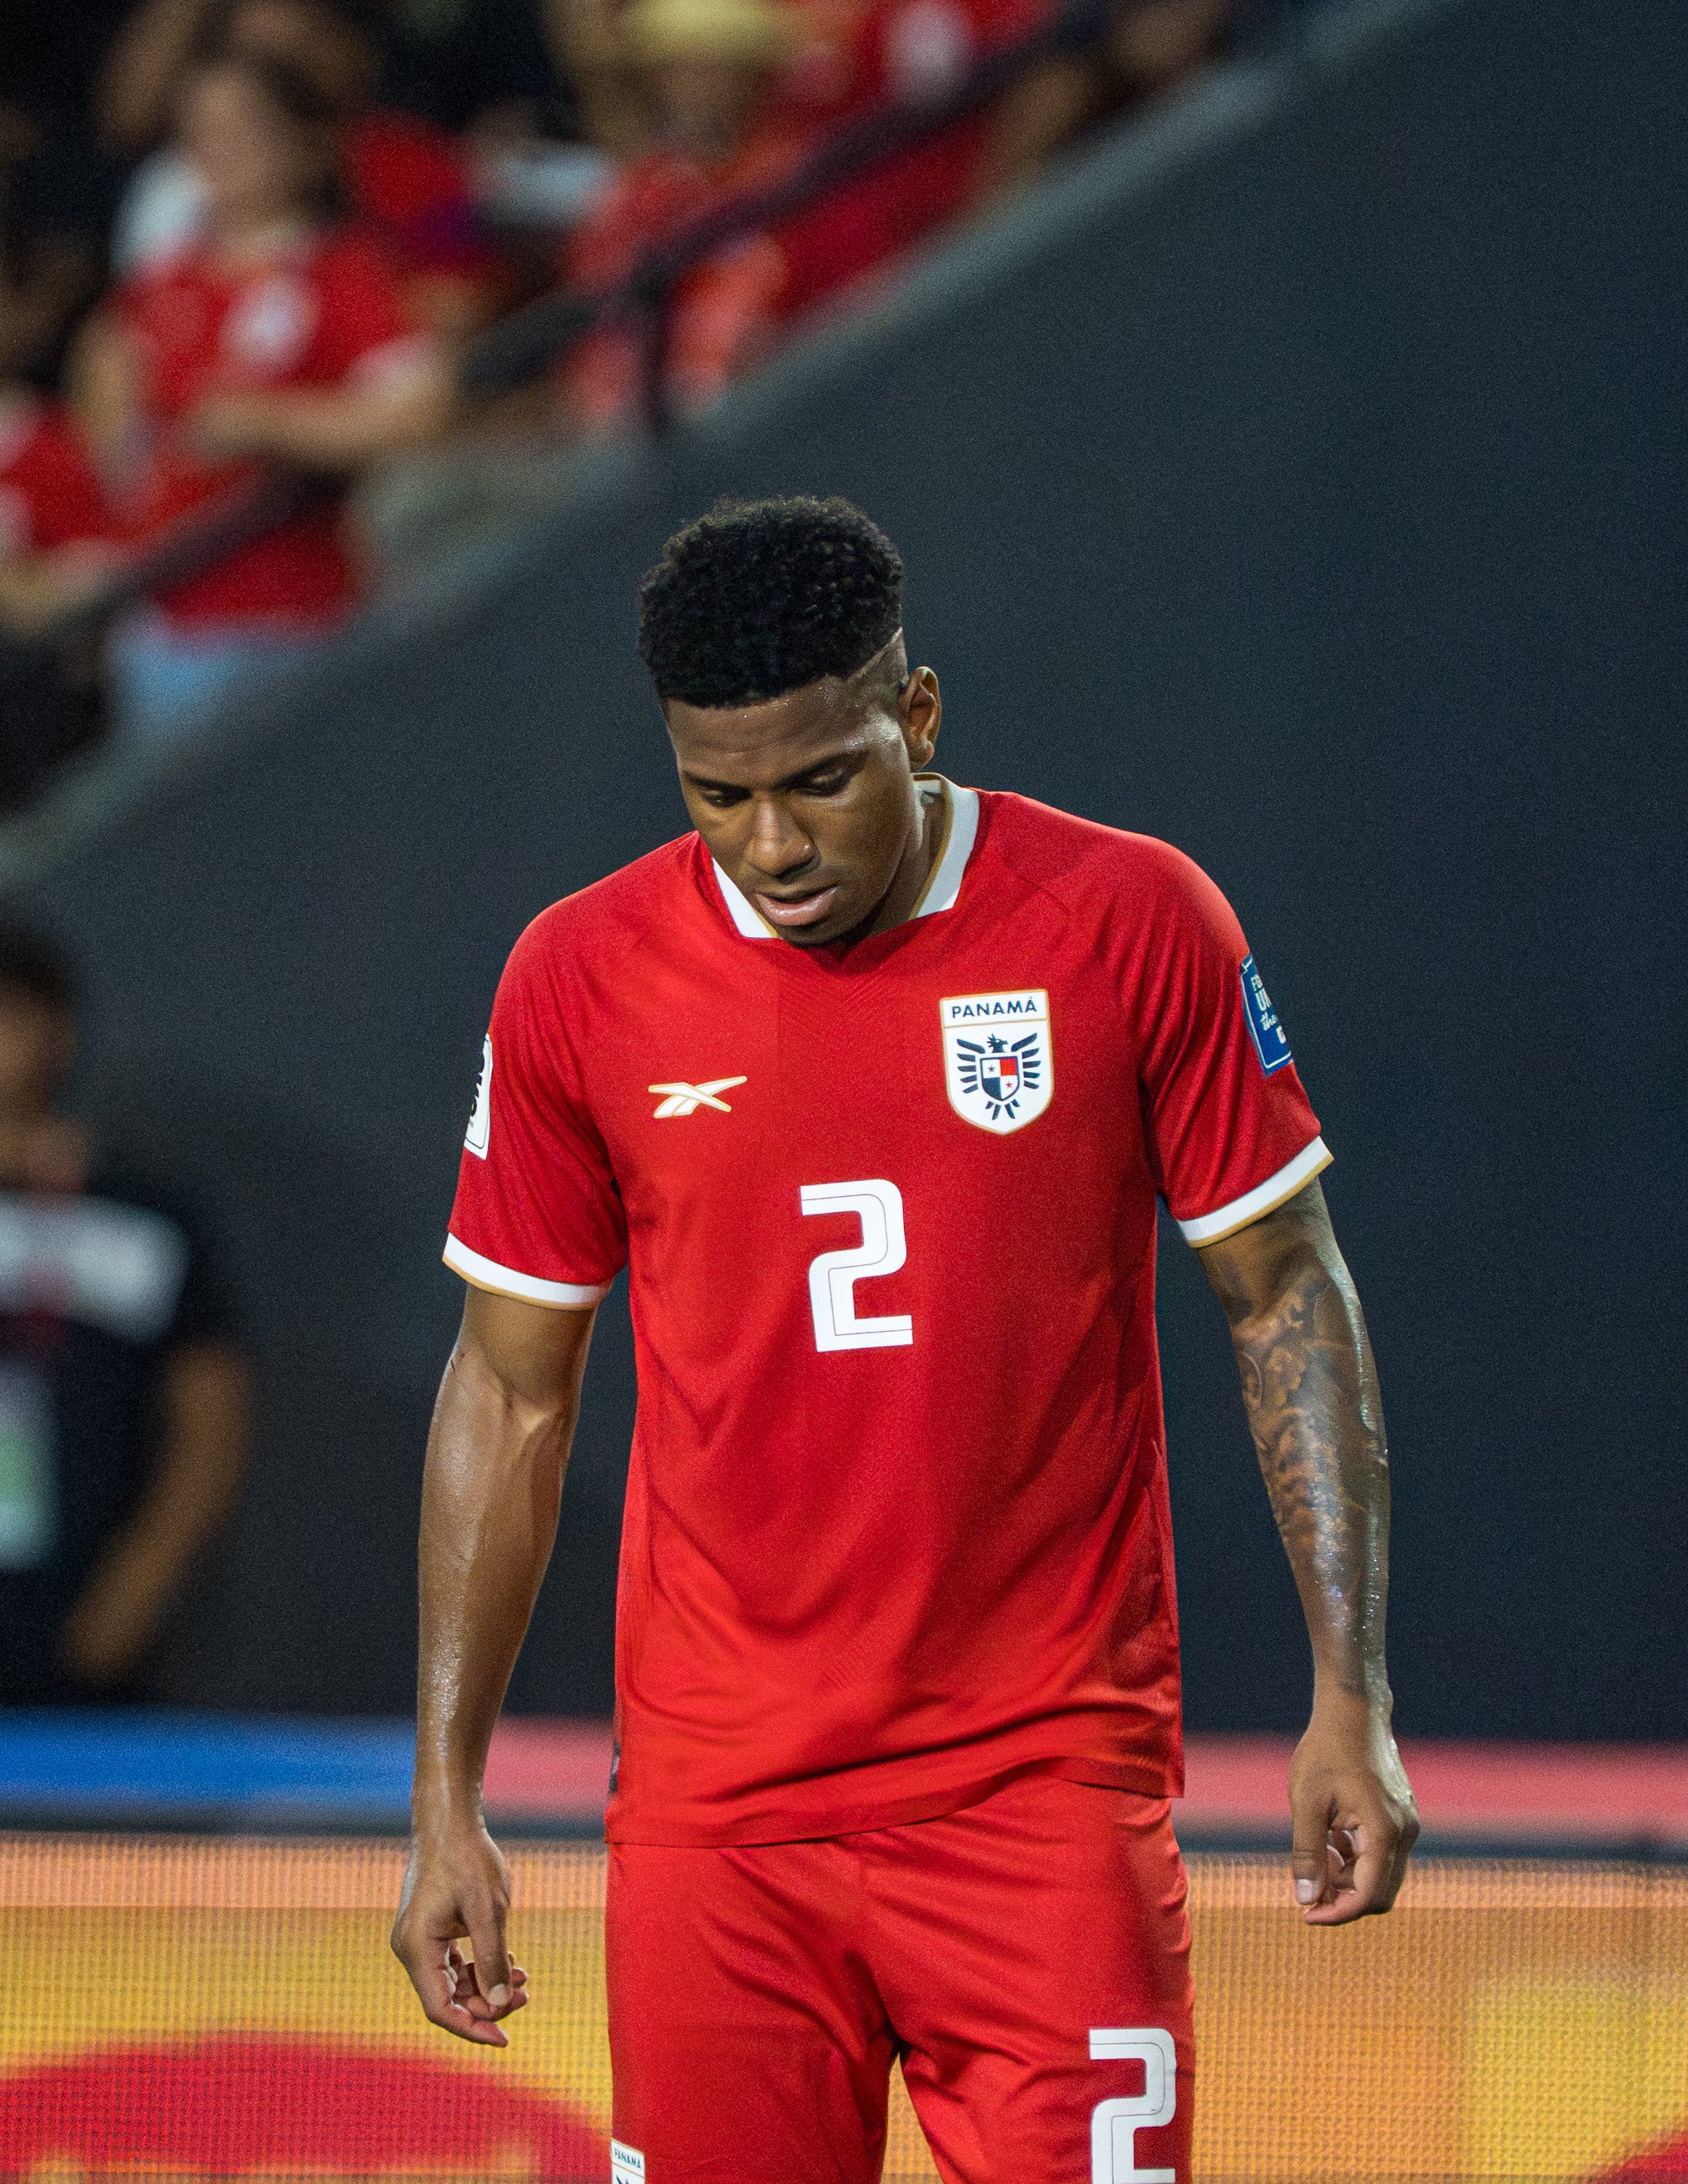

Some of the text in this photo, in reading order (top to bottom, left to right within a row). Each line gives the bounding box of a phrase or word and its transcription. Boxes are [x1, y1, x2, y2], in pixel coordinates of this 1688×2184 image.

[951, 997, 1037, 1019] PANAMÁ
[800, 1179, 914, 1353] 2
[1089, 2028, 1177, 2184] 2
